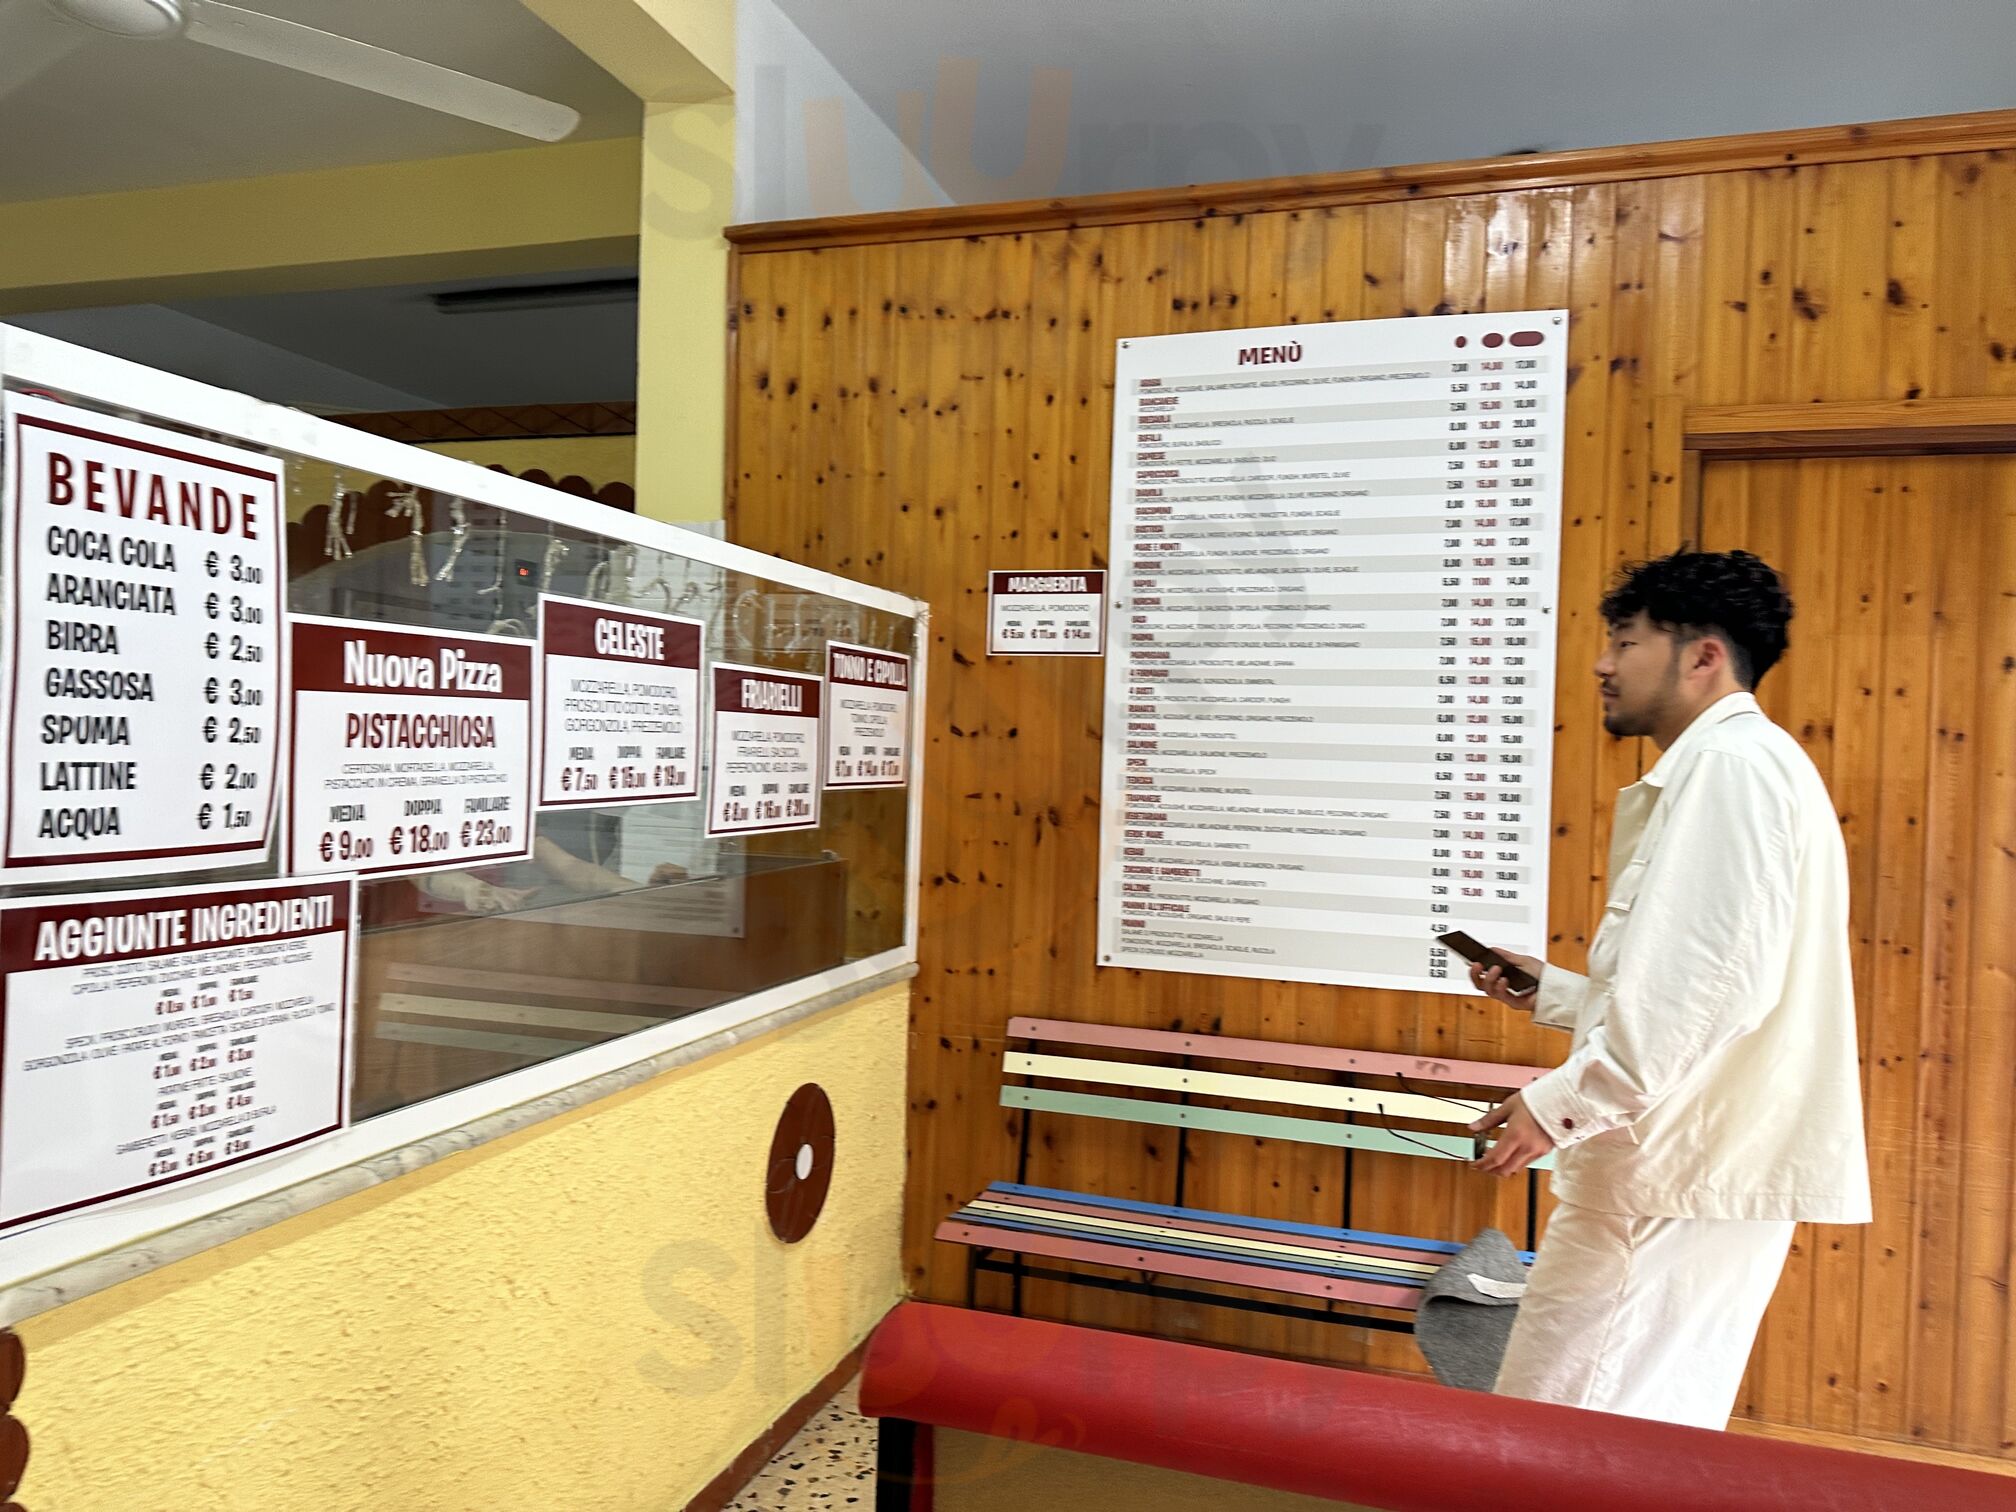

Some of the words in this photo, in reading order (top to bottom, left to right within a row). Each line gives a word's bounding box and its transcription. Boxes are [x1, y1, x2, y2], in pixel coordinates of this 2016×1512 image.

[1238, 341, 1302, 365] MENÙ
[48, 452, 259, 540] BEVANDE
[47, 526, 112, 562] COCA
[120, 536, 176, 572] COLA
[205, 550, 219, 578] €
[230, 554, 262, 585] 3,00
[46, 573, 177, 615] ARANCIATA
[205, 593, 219, 619] €
[230, 598, 263, 624] 3,00
[1008, 577, 1087, 592] MARGHERITA
[46, 620, 119, 655] BIRRA
[204, 634, 219, 660] €
[230, 637, 263, 663] 2,50
[596, 618, 664, 660] CELESTE
[344, 640, 435, 689] Nuova
[440, 648, 502, 693] Pizza
[868, 659, 873, 682] E
[45, 668, 154, 701] GASSOSA
[204, 678, 218, 704] €
[229, 681, 263, 707] 3,00
[742, 679, 802, 712] FRIARIELLI
[42, 716, 129, 745] SPUMA
[203, 717, 218, 743] €
[229, 719, 260, 745] 2,50
[345, 713, 495, 749] PISTACCHIOSA
[40, 762, 137, 791] LATTINE
[200, 764, 215, 790] €
[225, 764, 257, 791] 2,00
[561, 767, 572, 790] €
[609, 766, 619, 789] €
[654, 765, 662, 786] €
[38, 806, 121, 837] ACQUA
[197, 804, 212, 830] €
[223, 804, 252, 831] 1,50
[330, 805, 365, 822] MEDIA
[404, 799, 442, 816] DOPPIA
[320, 832, 333, 862] €
[389, 827, 403, 854] €
[410, 825, 448, 854] 18,00
[460, 821, 471, 847] €
[475, 819, 511, 846] 23,00
[34, 910, 186, 961] AGGIUNTE
[192, 895, 333, 944] INGREDIENTI
